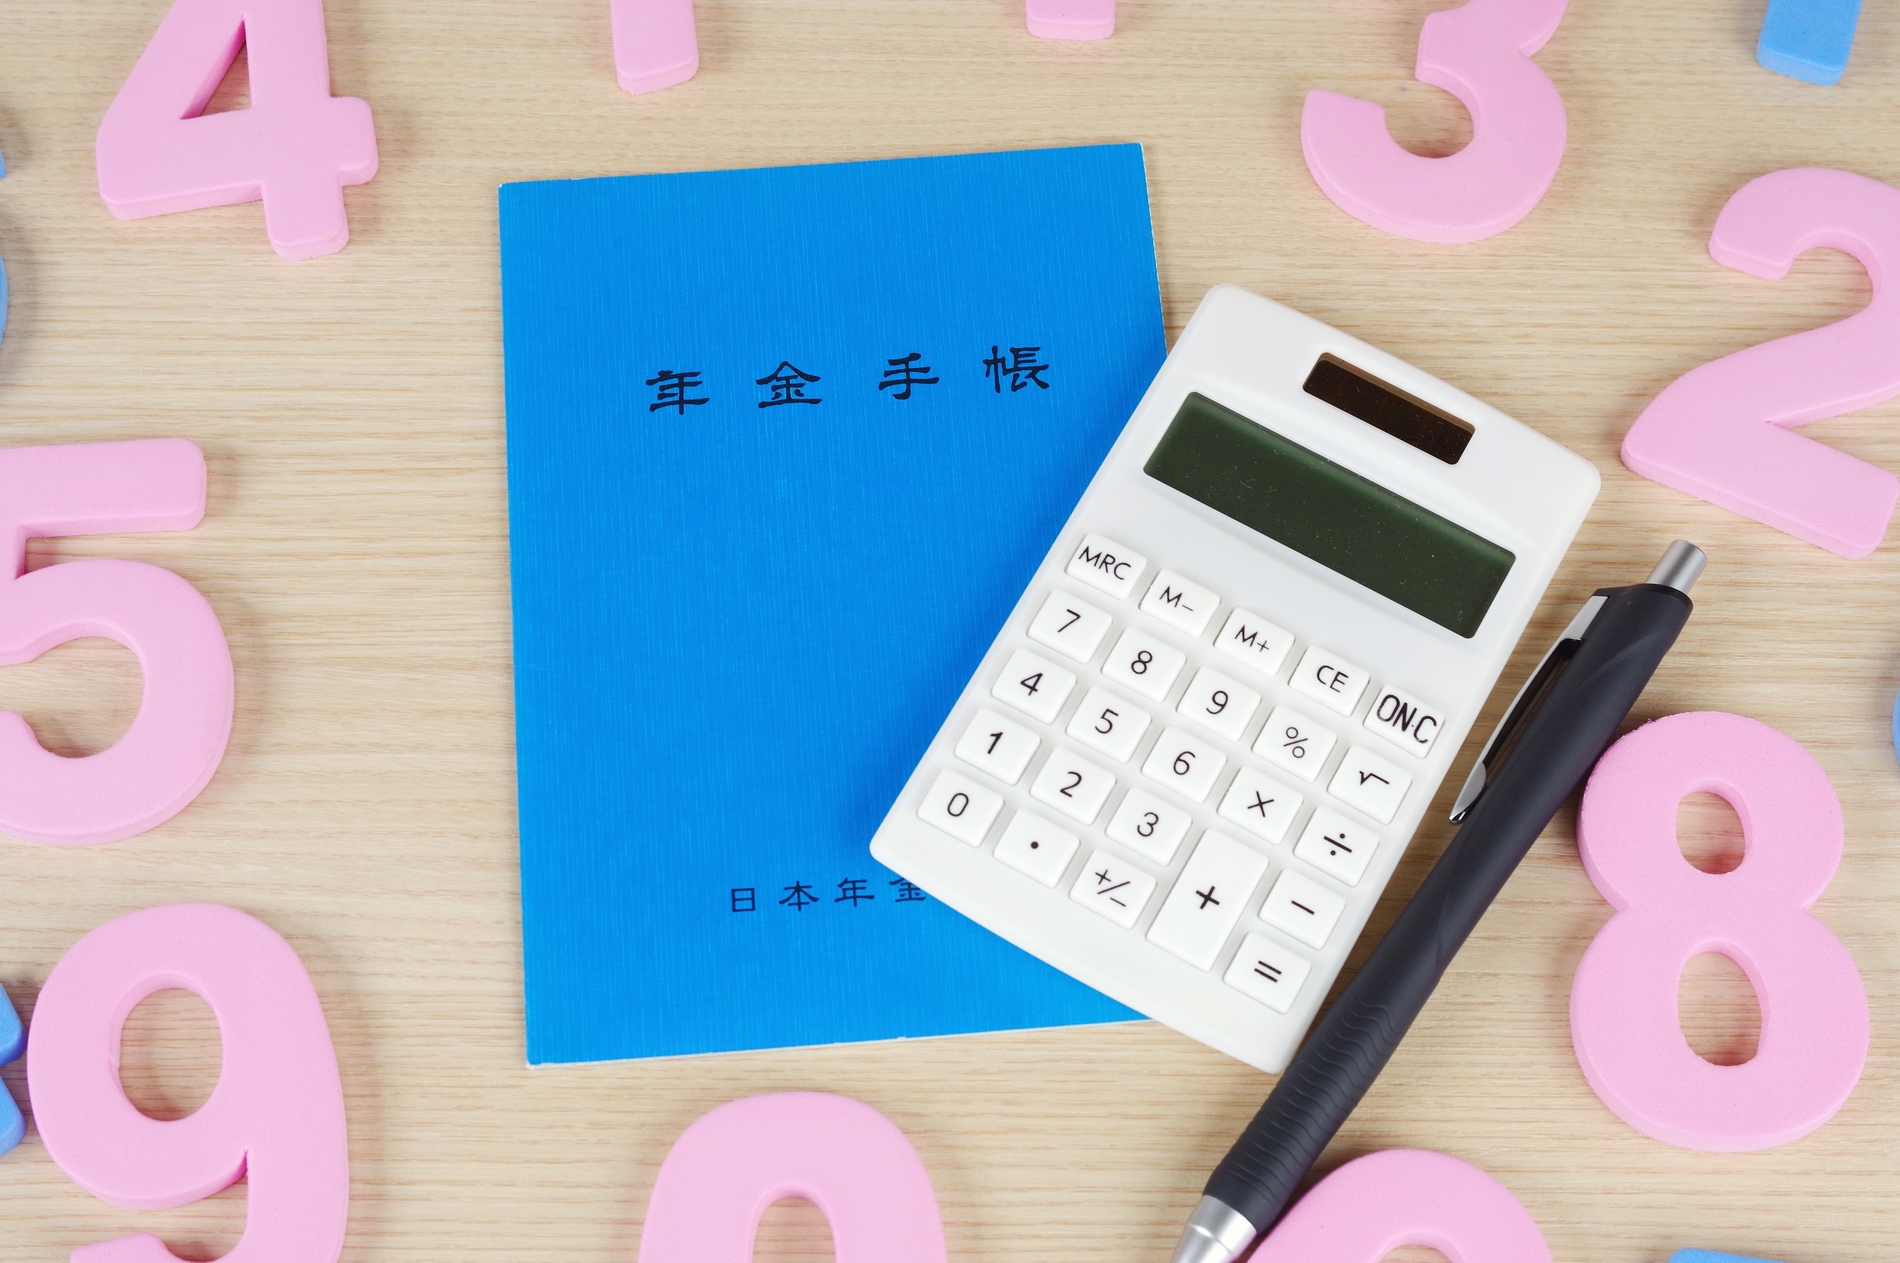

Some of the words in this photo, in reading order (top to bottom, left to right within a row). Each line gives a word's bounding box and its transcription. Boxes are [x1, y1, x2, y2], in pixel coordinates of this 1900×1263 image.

[645, 345, 1050, 415] 年金手帳
[1057, 608, 1081, 634] 7
[1130, 650, 1154, 675] 8
[1206, 690, 1230, 716] 9
[1078, 546, 1132, 581] MRC
[1234, 625, 1271, 653] M+
[1316, 665, 1350, 694] CE
[1020, 672, 1045, 697] 4
[1094, 708, 1120, 735] 5
[1173, 750, 1197, 777] 6
[947, 792, 970, 818] 0
[987, 731, 1005, 756] 1
[1059, 771, 1083, 799] 2
[1137, 811, 1160, 839] 3
[1570, 711, 1870, 1153] 8
